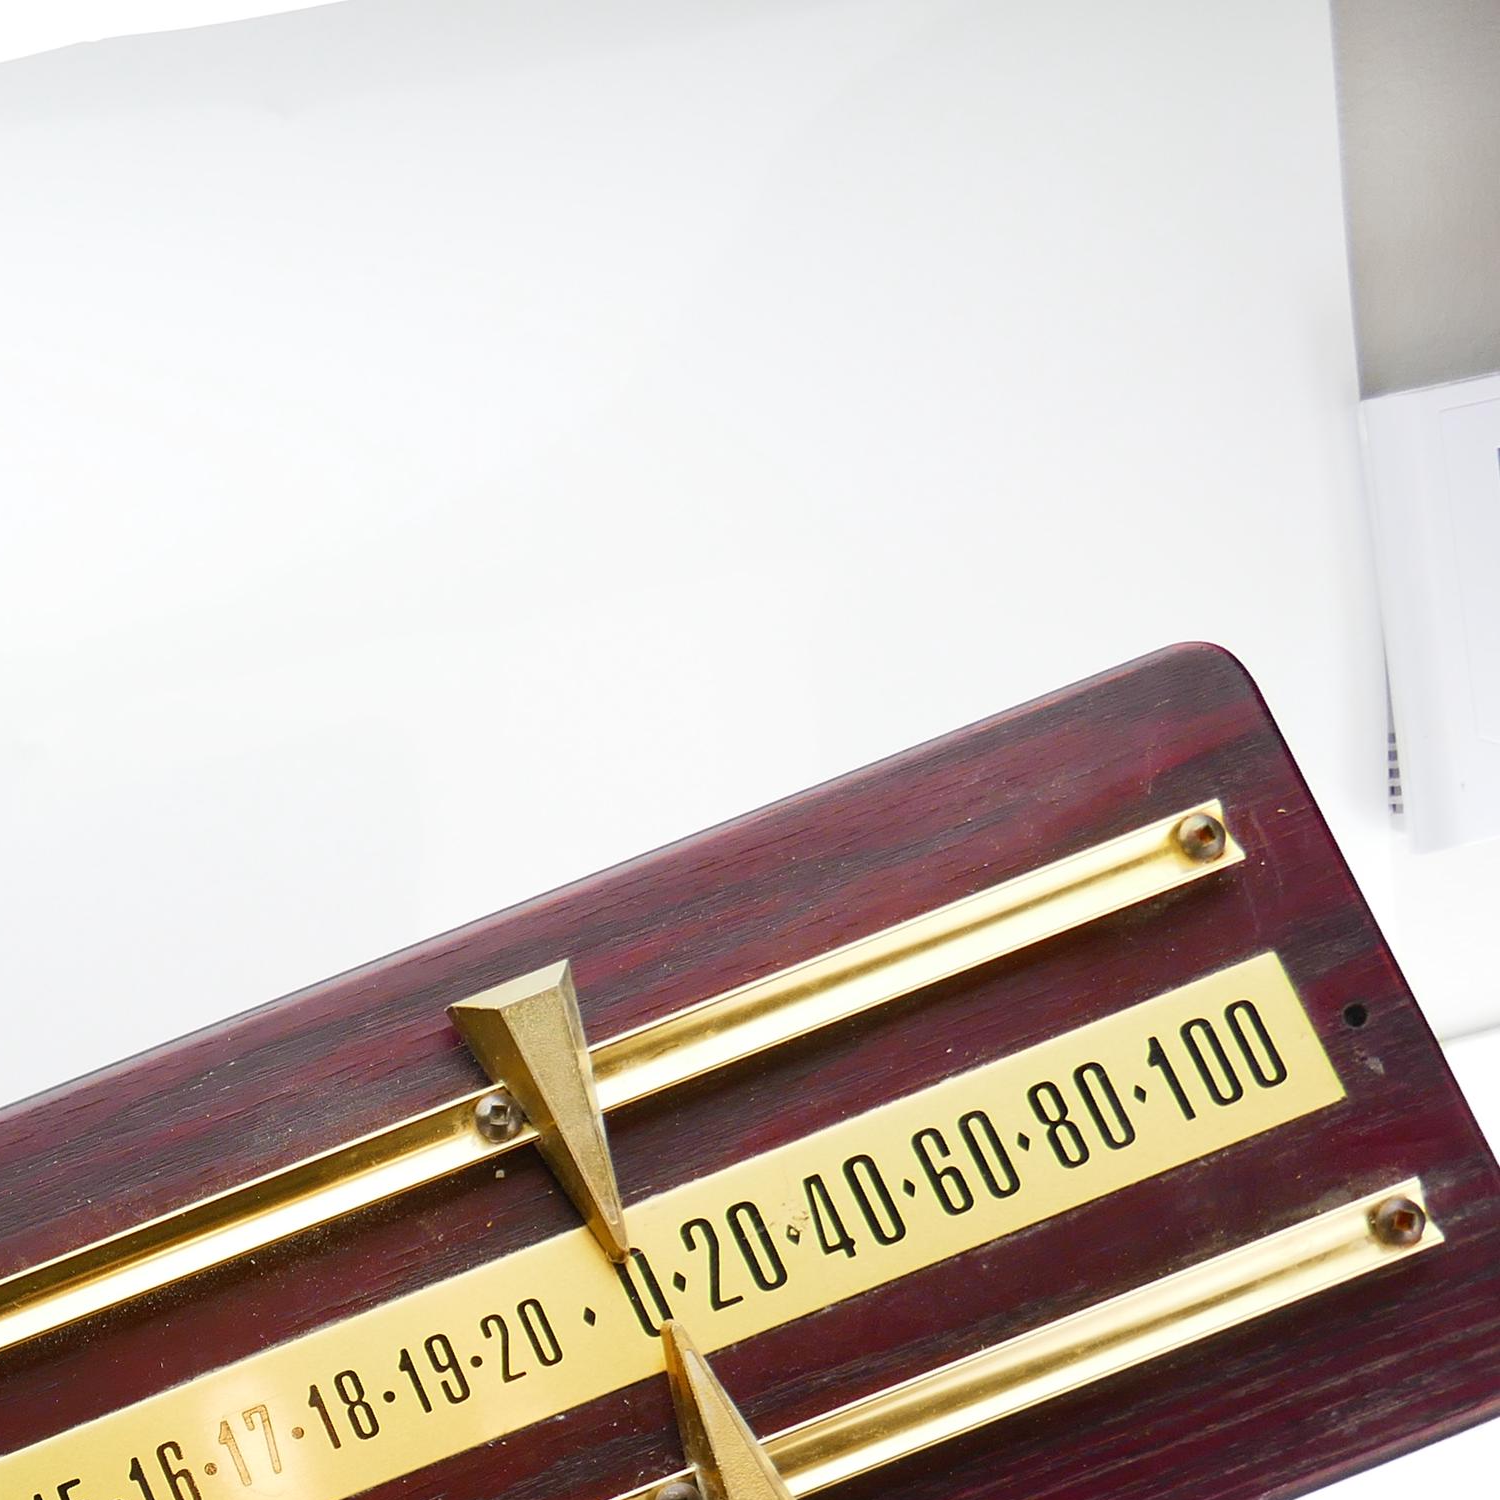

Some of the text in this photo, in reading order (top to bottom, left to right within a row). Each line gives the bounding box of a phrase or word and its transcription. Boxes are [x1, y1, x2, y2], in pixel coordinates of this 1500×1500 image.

[218, 1404, 283, 1487] 17
[308, 1369, 380, 1449] 18
[398, 1333, 471, 1413] 19
[480, 1298, 563, 1383] 20
[612, 1247, 674, 1338] 0
[680, 1201, 788, 1311] 20
[803, 1156, 907, 1258] 40
[911, 1110, 1021, 1216] 60
[1026, 1061, 1136, 1169] 80
[1147, 999, 1288, 1121] 100
